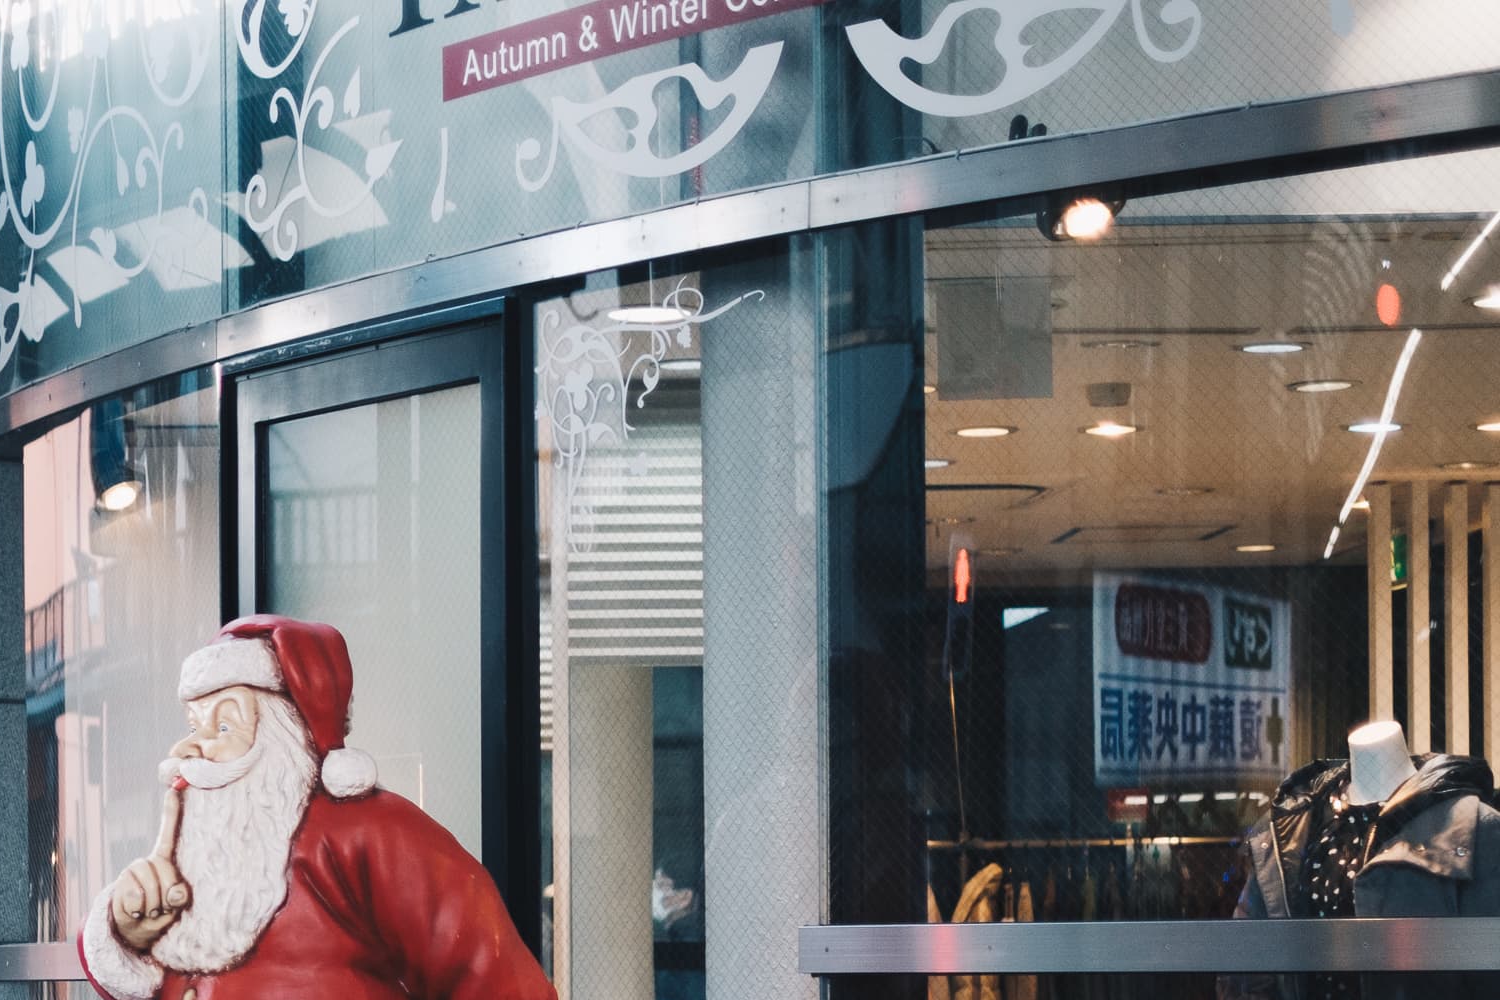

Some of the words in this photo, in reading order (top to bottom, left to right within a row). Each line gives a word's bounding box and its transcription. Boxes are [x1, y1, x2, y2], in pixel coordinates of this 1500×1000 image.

[463, 31, 567, 86] Autumn
[578, 15, 599, 52] &
[610, 0, 707, 43] Winter
